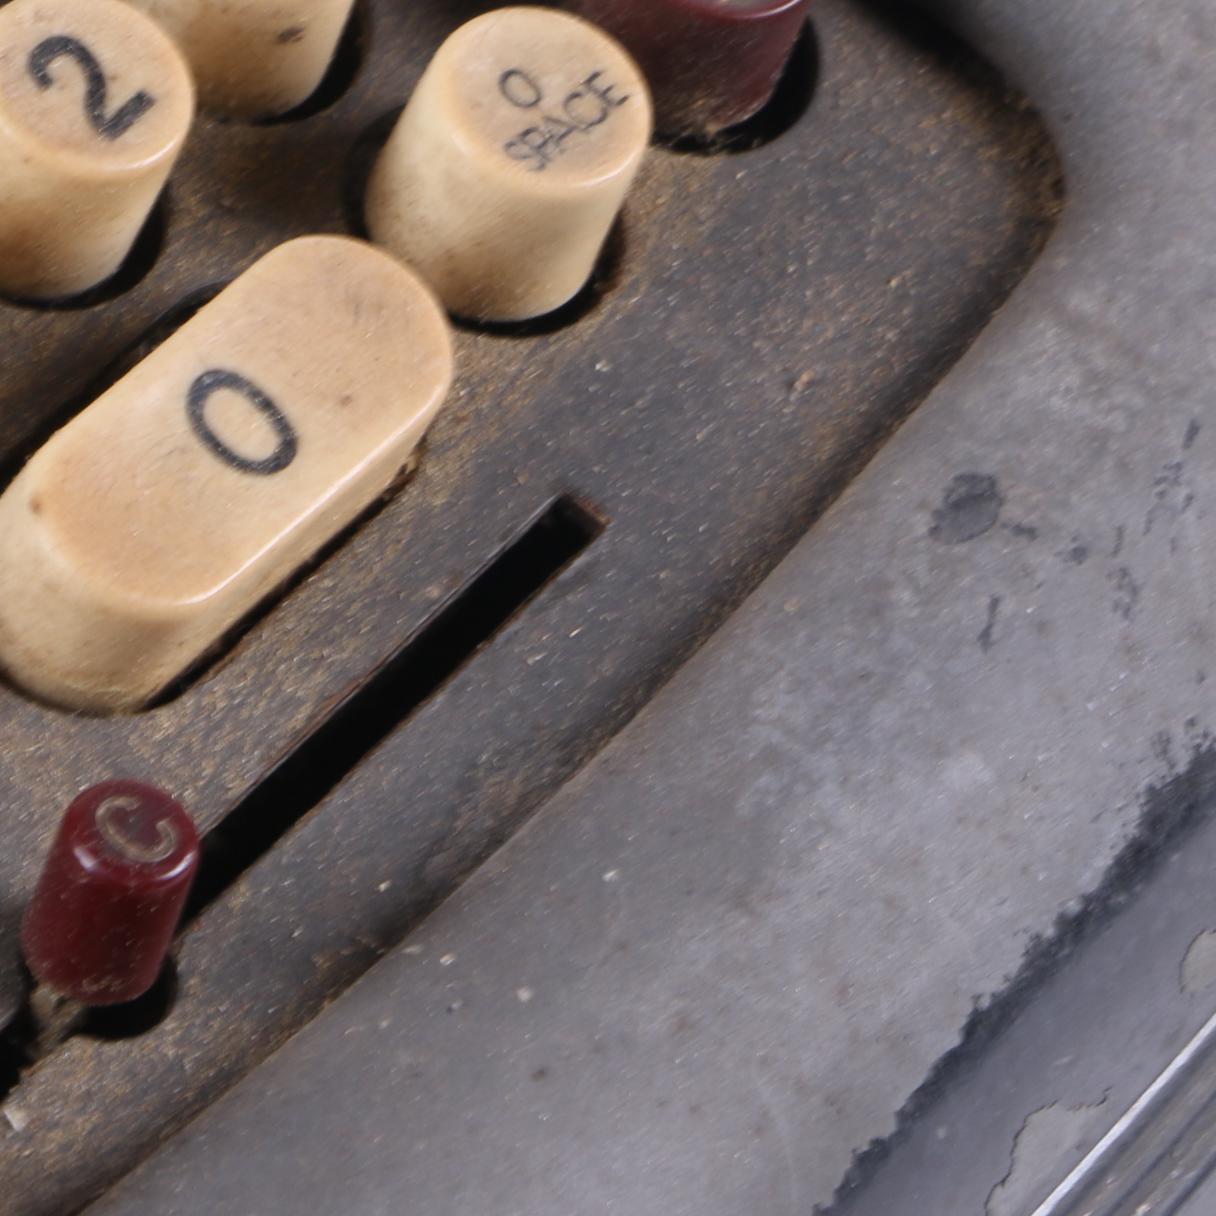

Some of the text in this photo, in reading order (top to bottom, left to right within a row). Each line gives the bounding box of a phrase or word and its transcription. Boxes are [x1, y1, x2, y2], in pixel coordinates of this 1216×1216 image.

[26, 34, 158, 142] 2
[504, 70, 631, 172] SPACE
[94, 793, 177, 863] C
